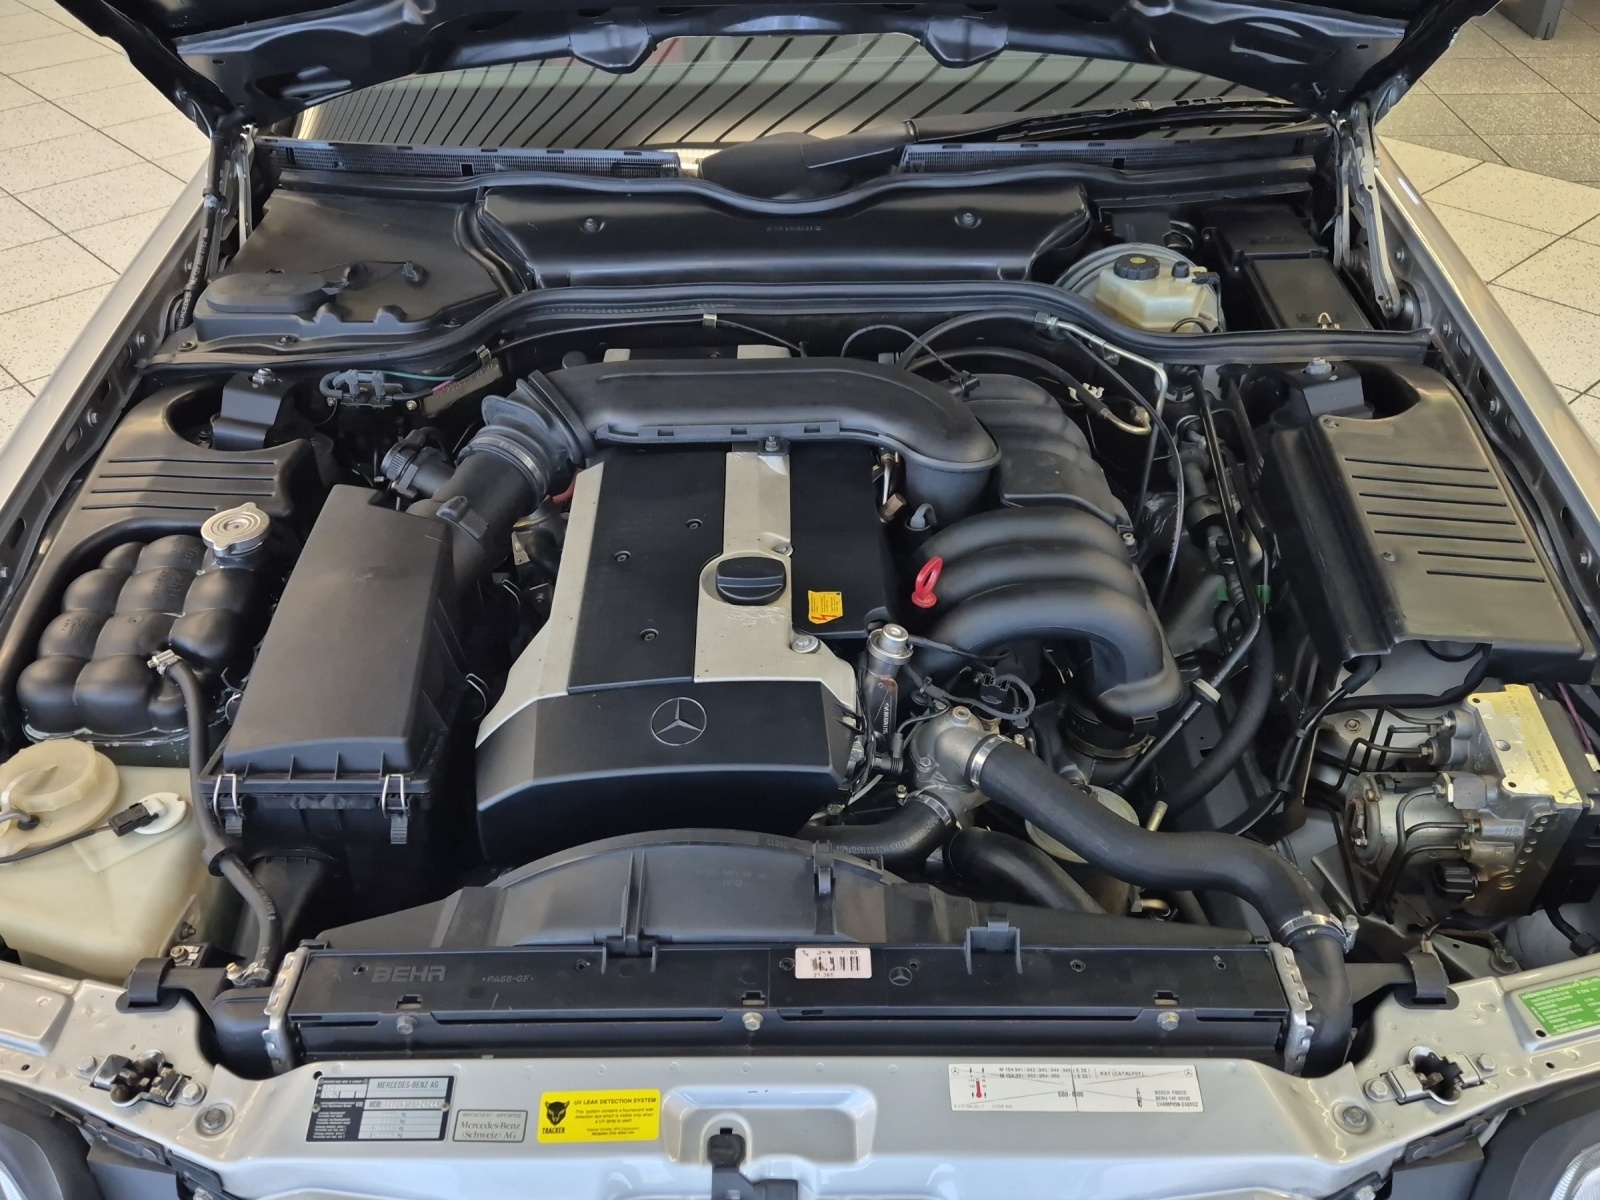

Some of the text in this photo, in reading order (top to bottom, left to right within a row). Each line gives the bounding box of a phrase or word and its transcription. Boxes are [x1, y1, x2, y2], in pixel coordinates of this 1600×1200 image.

[372, 965, 447, 983] BEHR
[376, 1081, 429, 1089] MERCEDES-BENZ
[461, 1121, 521, 1130] Mercedes-Benz
[462, 1130, 516, 1140] (Schweiz) AG
